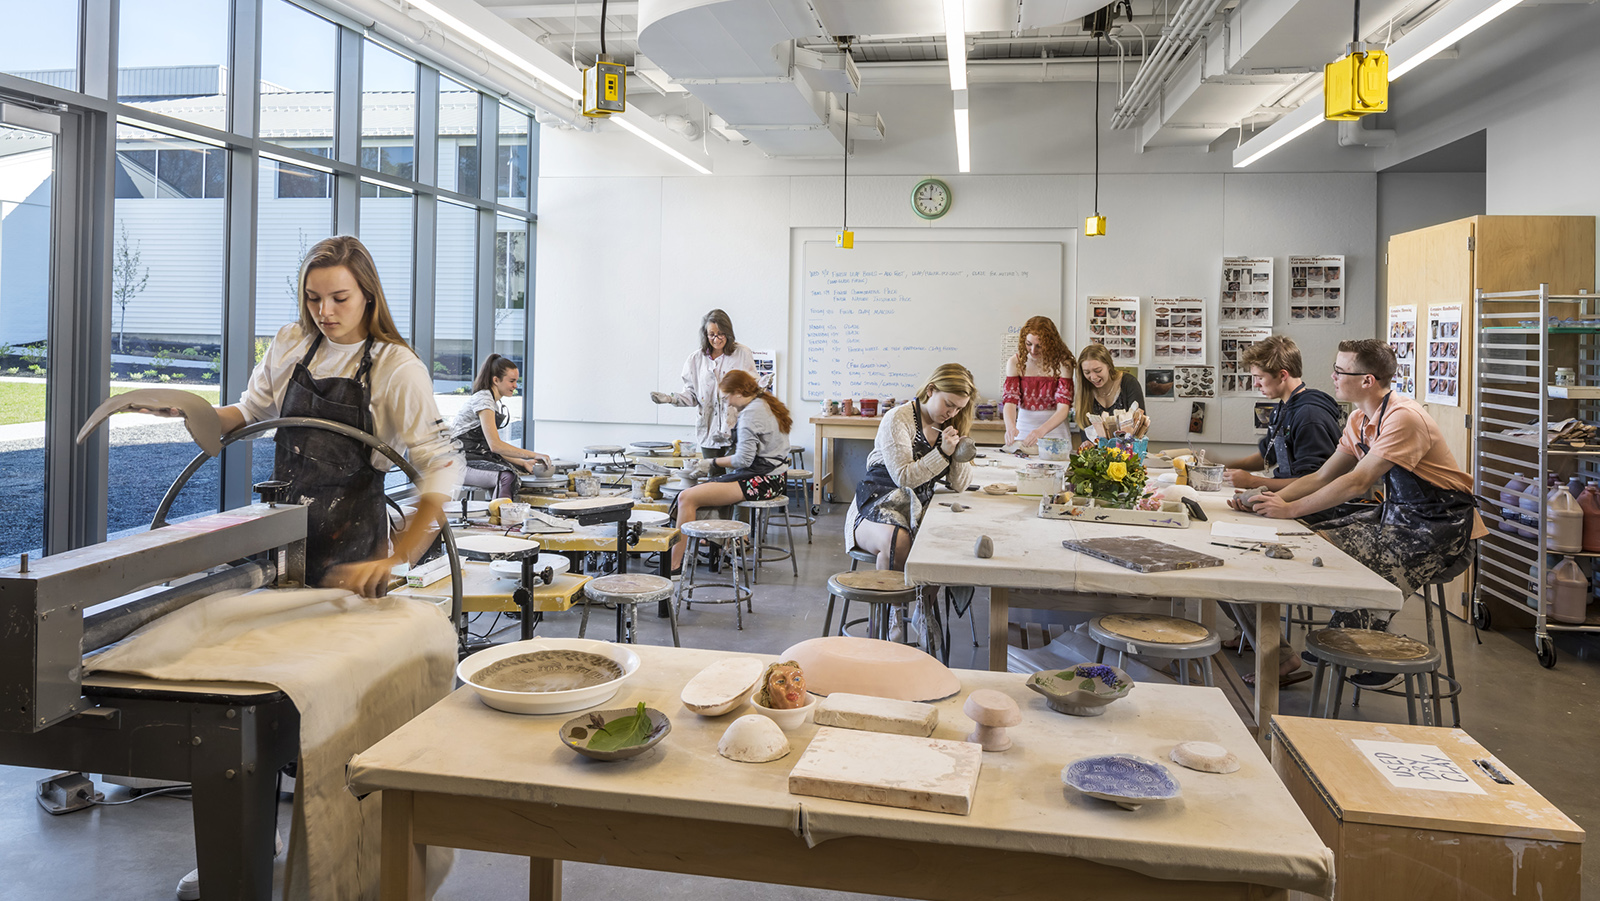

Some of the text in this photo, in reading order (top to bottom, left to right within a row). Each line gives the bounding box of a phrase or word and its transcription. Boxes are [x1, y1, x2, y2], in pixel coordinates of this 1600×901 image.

[1374, 752, 1416, 778] USED
[1401, 757, 1442, 781] DRY
[1420, 753, 1470, 783] CLAY
